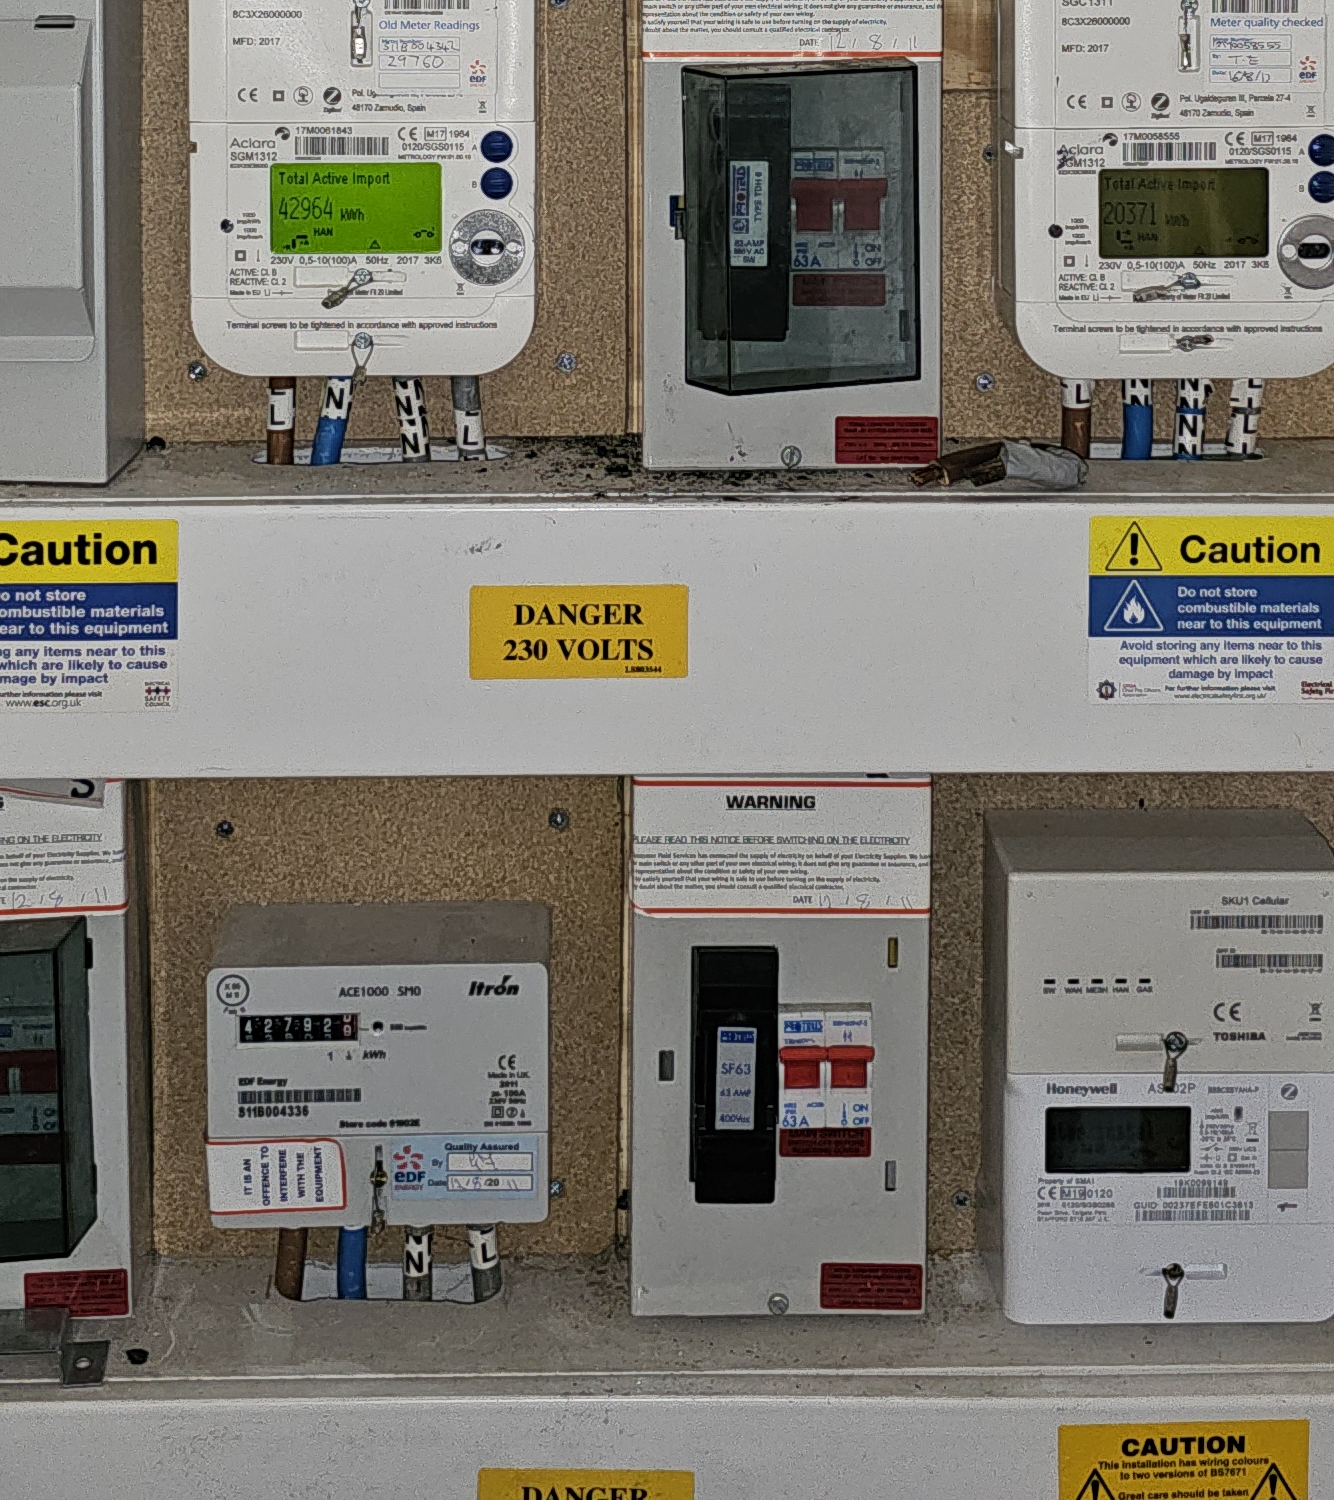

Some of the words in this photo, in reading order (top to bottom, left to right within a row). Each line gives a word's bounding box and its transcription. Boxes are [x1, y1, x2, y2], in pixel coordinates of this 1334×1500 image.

[378, 19, 397, 31] Old
[400, 19, 430, 31] Meter
[432, 19, 480, 33] Readings
[1210, 17, 1240, 28] Meter
[1243, 17, 1279, 30] quality
[1281, 16, 1324, 28] checked
[230, 137, 276, 150] Aclara
[230, 151, 278, 162] SGM1312
[278, 171, 309, 186] Total
[312, 171, 349, 186] Active
[352, 171, 391, 188] Import
[277, 196, 334, 221] 42964
[339, 208, 365, 222] kWh
[270, 256, 294, 266] 230V
[366, 256, 389, 266] 50Hz
[396, 256, 419, 266] 2017
[1179, 535, 1321, 565] Caution
[15, 589, 42, 602] not
[45, 590, 86, 601] store
[1177, 587, 1196, 598] Do
[1199, 587, 1220, 598] not
[1224, 587, 1258, 598] store
[90, 604, 164, 618] materials
[513, 603, 645, 626] DANGER
[1177, 602, 1257, 615] combustible
[1260, 602, 1320, 614] materials
[28, 622, 45, 635] to
[50, 622, 80, 635] this
[84, 622, 169, 638] equipment
[1177, 619, 1207, 630] near
[1210, 619, 1223, 630] to
[1226, 618, 1251, 630] this
[1253, 618, 1323, 633] equipment
[14, 647, 40, 661] any
[43, 646, 82, 657] items
[86, 647, 118, 657] near
[121, 646, 135, 657] to
[139, 645, 166, 657] this
[503, 638, 548, 661] 230
[556, 638, 654, 661] VOLTS
[1119, 640, 1153, 651] Avoid
[1156, 640, 1198, 654] storing
[1200, 642, 1221, 654] any
[1224, 640, 1256, 651] items
[1257, 642, 1283, 651] near
[1285, 641, 1298, 651] to
[1300, 640, 1323, 651] this
[40, 661, 64, 671] are
[67, 659, 105, 673] likely
[107, 660, 122, 671] to
[126, 660, 168, 670] cause
[1118, 655, 1180, 667] equipment
[1183, 654, 1218, 665] which
[1220, 656, 1239, 665] are
[1241, 653, 1272, 667] likely
[1274, 654, 1286, 665] to
[1289, 656, 1323, 665] cause
[40, 672, 58, 687] by
[61, 672, 109, 686] impact
[1168, 669, 1215, 681] damage
[1217, 668, 1232, 681] by
[1235, 668, 1274, 681] impact
[5, 698, 82, 709] www.esc.org.uk
[725, 795, 816, 809] WARNING
[1221, 895, 1250, 907] SKU1
[1252, 895, 1289, 906] Cellular
[1213, 1032, 1266, 1041] TOSHIBA
[720, 1063, 752, 1076] SF63
[1046, 1083, 1118, 1097] Honeywell
[260, 1146, 269, 1160] TO
[296, 1152, 305, 1172] THE
[278, 1149, 288, 1202] INTERFERE
[313, 1146, 324, 1203] EQUIPMENT
[261, 1162, 271, 1206] OFFENCE
[297, 1174, 305, 1198] WITH
[1121, 1435, 1246, 1457] CAUTION
[1098, 1460, 1120, 1470] This
[1121, 1459, 1177, 1469] installation
[1178, 1459, 1197, 1467] has
[1198, 1458, 1230, 1468] wiring
[1232, 1456, 1270, 1466] colours
[1119, 1472, 1130, 1481] to
[1132, 1472, 1151, 1480] two
[1152, 1470, 1196, 1479] versions
[1198, 1469, 1208, 1478] of
[1210, 1468, 1247, 1477] BS7671
[521, 1486, 648, 1500] DANGER
